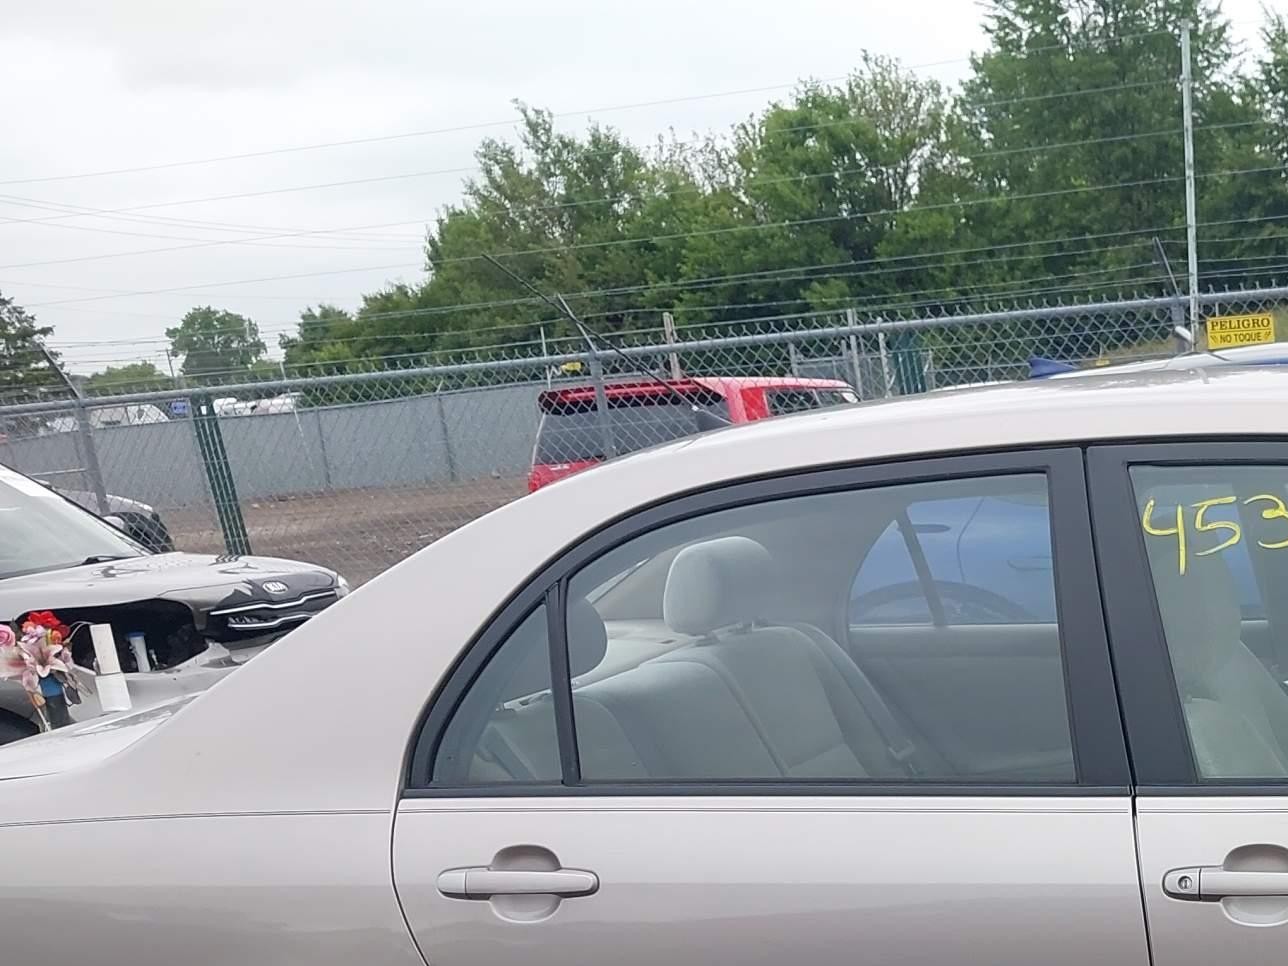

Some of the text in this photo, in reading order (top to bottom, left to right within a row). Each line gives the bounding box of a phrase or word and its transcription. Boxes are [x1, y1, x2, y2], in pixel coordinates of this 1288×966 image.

[1210, 317, 1271, 331] PELIGRO
[1220, 332, 1262, 344] NO TOQUE
